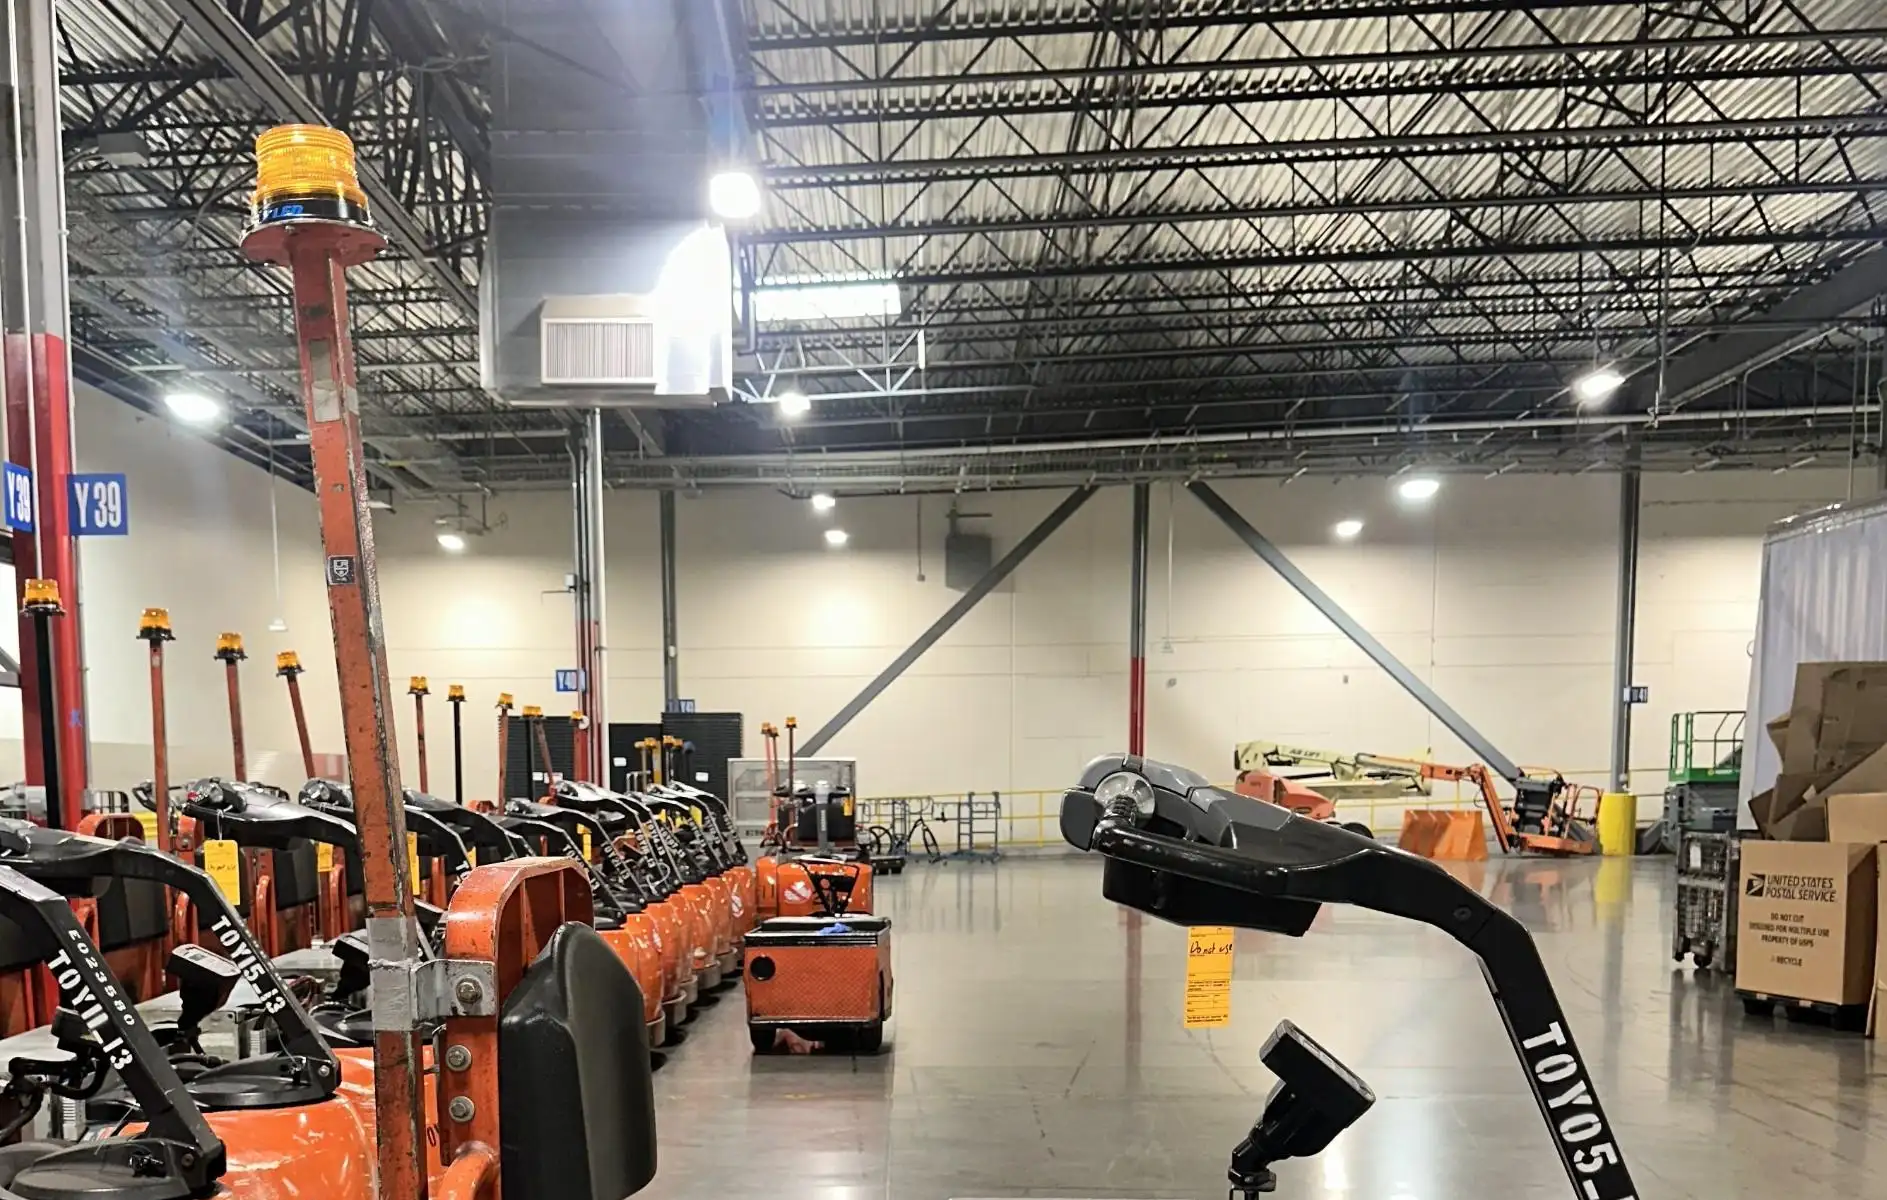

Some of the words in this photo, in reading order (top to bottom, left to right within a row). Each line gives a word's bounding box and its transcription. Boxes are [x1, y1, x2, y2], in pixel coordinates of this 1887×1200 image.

[1767, 875, 1799, 887] UNITED
[1801, 877, 1834, 888] STATES
[1765, 887, 1795, 900] POSTAL
[1799, 889, 1836, 902] SERVICE
